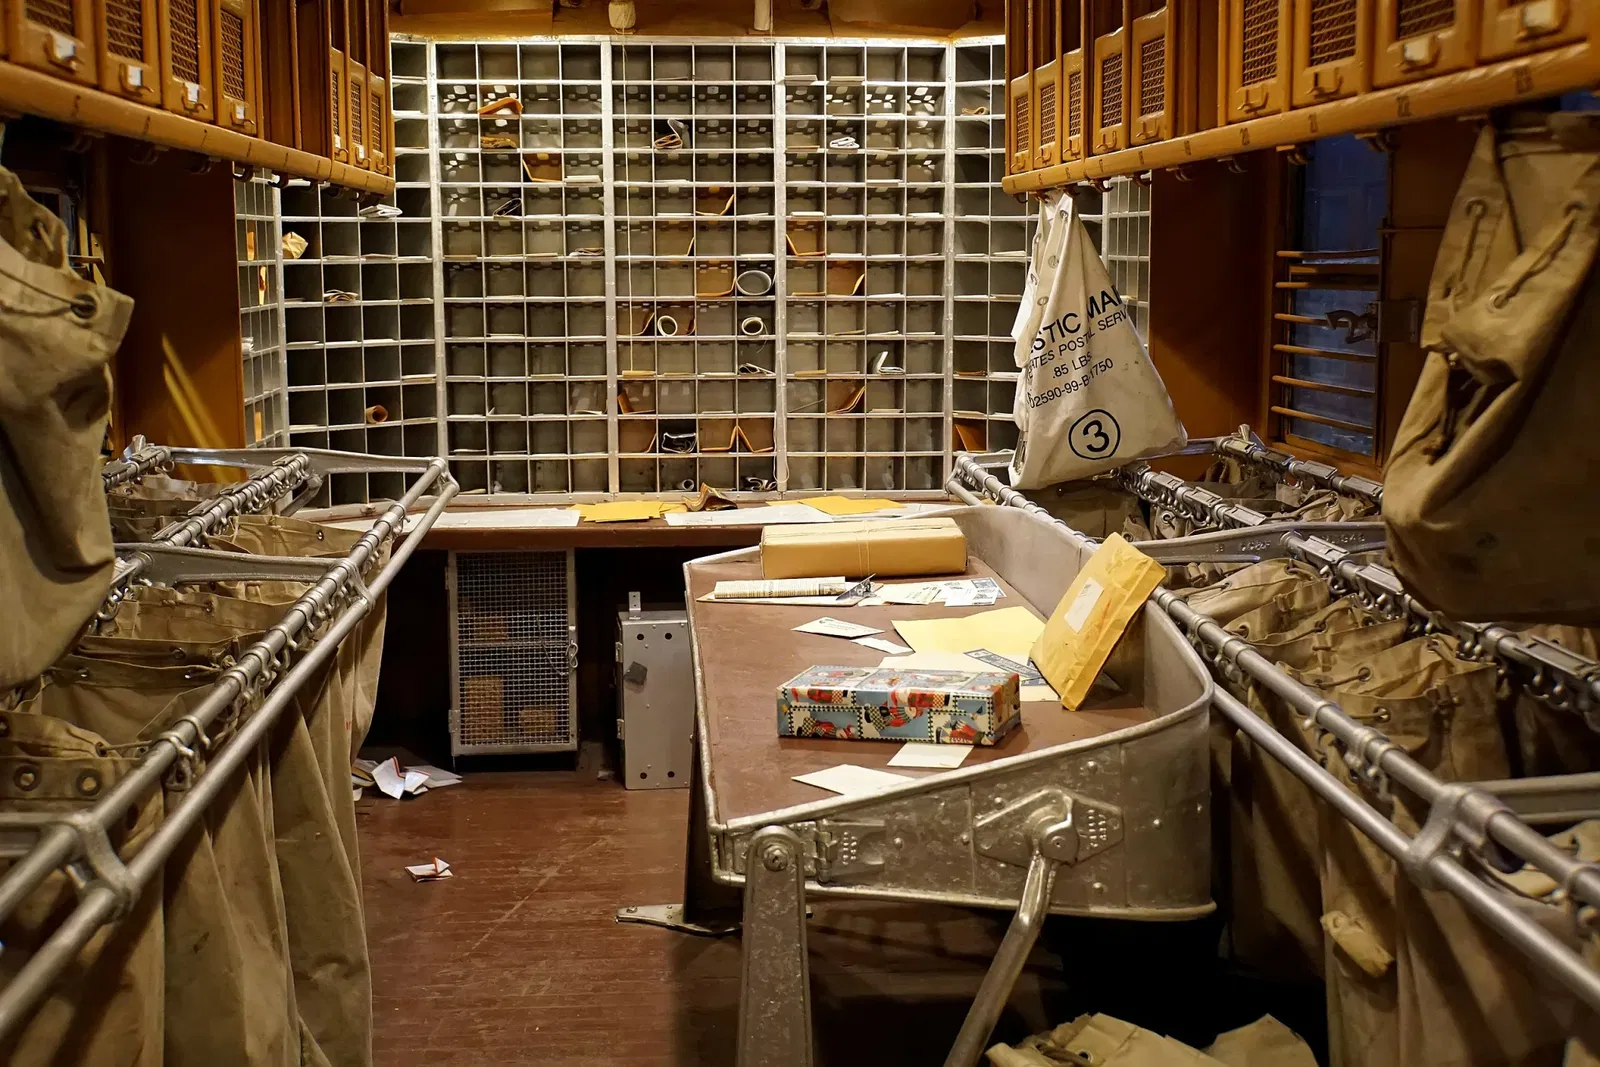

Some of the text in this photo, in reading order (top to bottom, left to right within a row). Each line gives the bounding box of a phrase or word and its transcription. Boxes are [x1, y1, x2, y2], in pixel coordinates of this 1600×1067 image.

[1029, 349, 1055, 371] ATES
[1058, 329, 1096, 357] POSTL
[1030, 312, 1082, 354] STIC
[1071, 351, 1093, 371] LBS
[1082, 419, 1110, 453] 3
